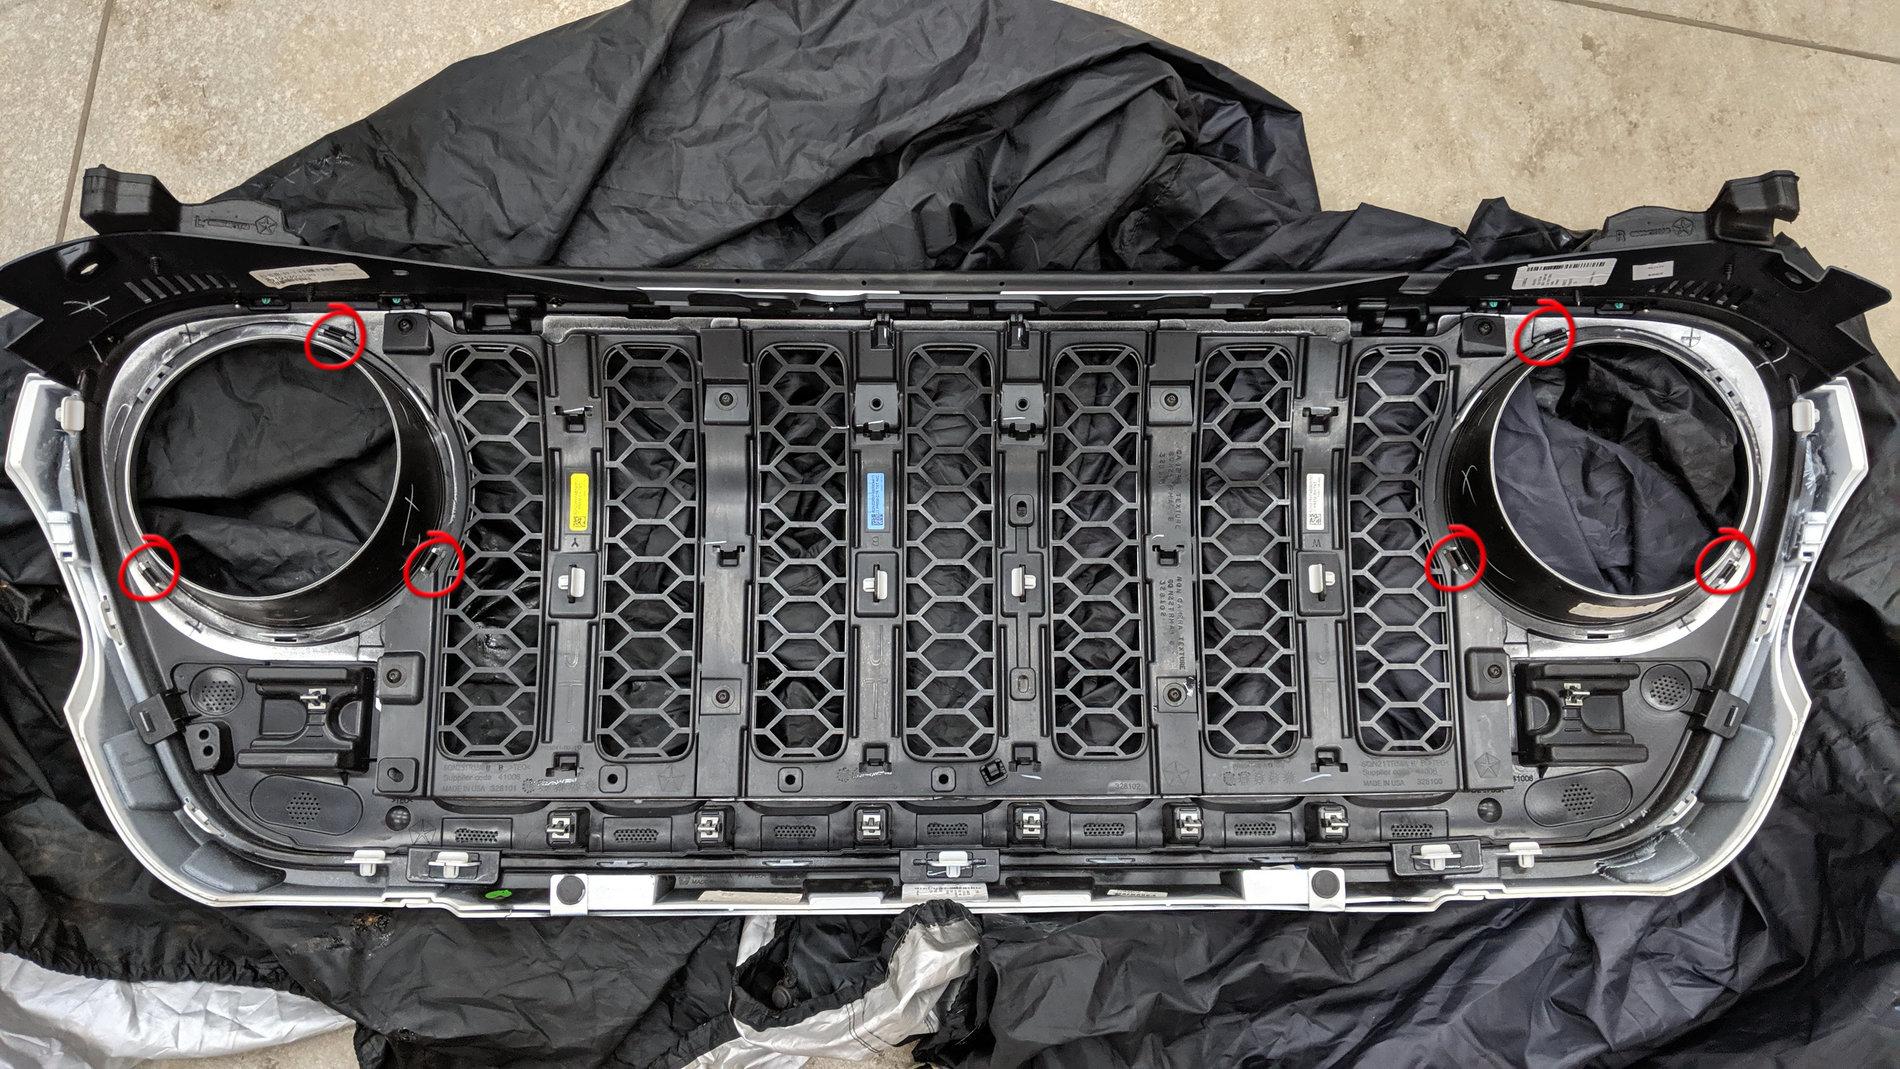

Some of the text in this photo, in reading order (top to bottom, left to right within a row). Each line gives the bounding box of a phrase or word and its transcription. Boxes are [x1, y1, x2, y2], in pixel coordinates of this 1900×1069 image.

[1174, 493, 1182, 529] TEXTURE
[1159, 580, 1167, 617] 328102
[1176, 597, 1184, 630] CAMERA
[1178, 636, 1186, 670] TEXTURE
